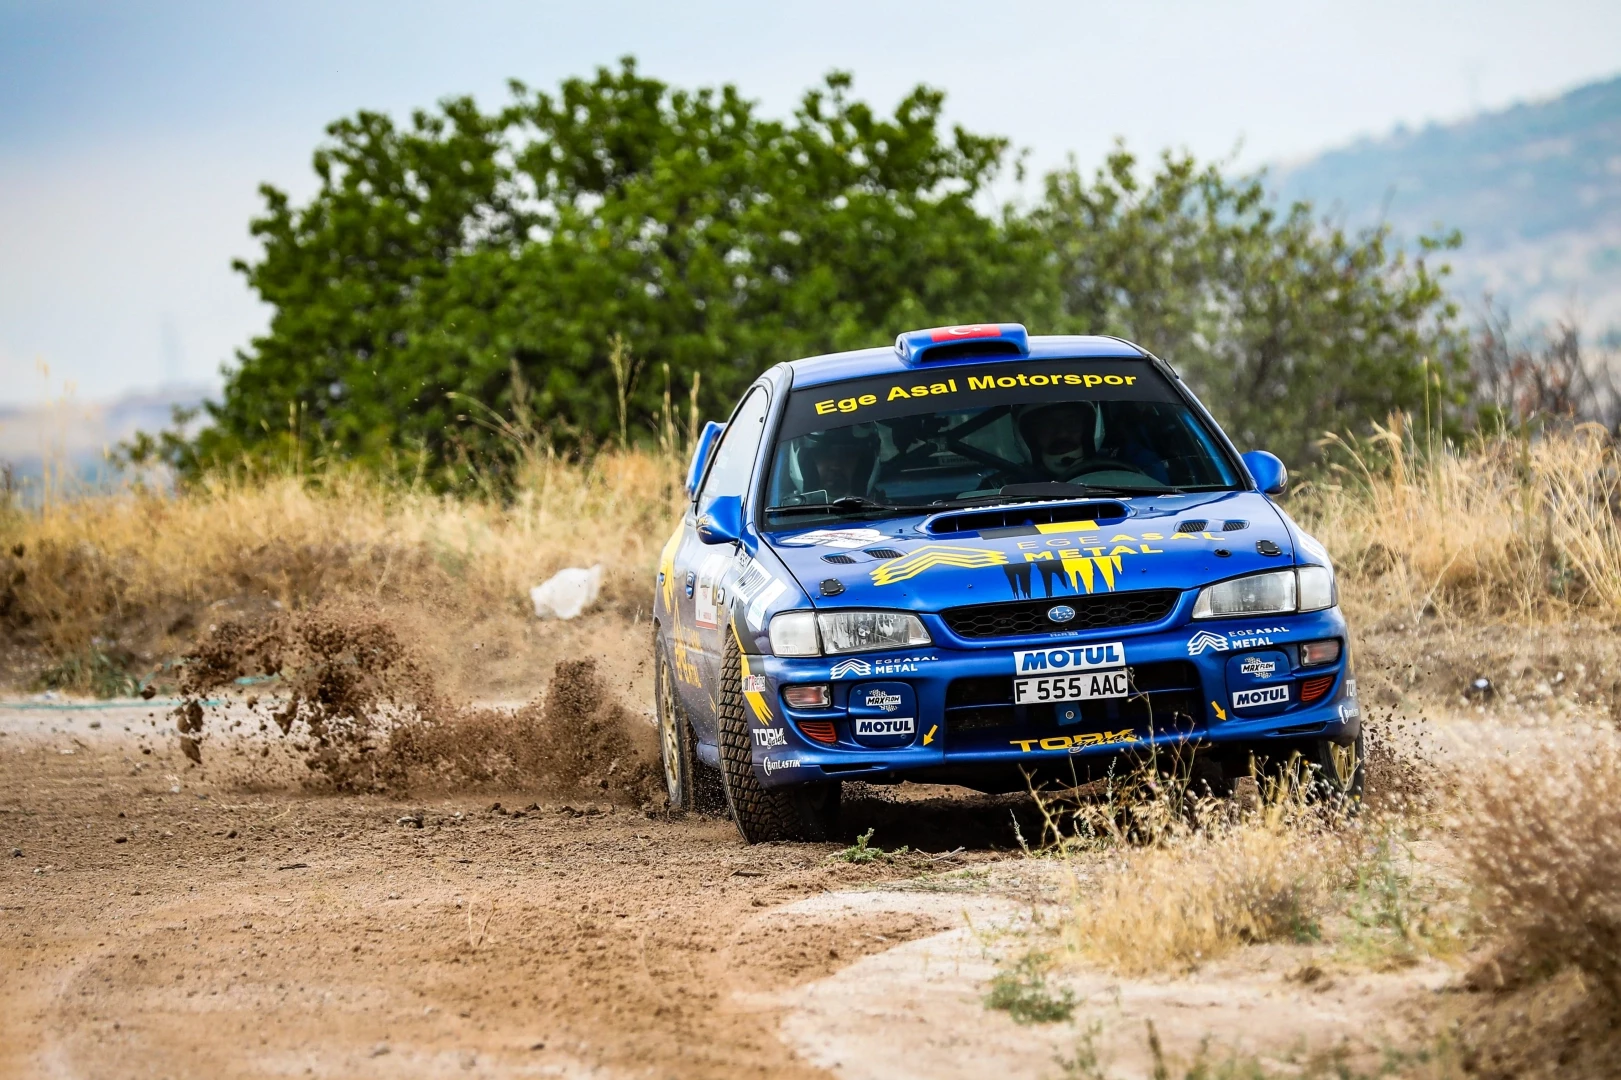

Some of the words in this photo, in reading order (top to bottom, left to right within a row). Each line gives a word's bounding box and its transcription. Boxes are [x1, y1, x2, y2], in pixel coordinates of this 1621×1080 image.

[814, 393, 877, 416] Ege
[886, 379, 958, 401] Asal
[967, 372, 1137, 391] Motorspor
[1023, 543, 1164, 562] METAL
[1232, 637, 1274, 649] METAL
[1021, 645, 1120, 671] MOTUL
[875, 664, 918, 674] METAL
[1015, 681, 1028, 702] F
[1037, 677, 1082, 701] 555
[1089, 673, 1127, 697] AAC
[1236, 688, 1287, 706] MOTUL
[859, 720, 911, 733] MOTUL
[752, 728, 788, 746] TORK
[1009, 728, 1138, 753] TORK
